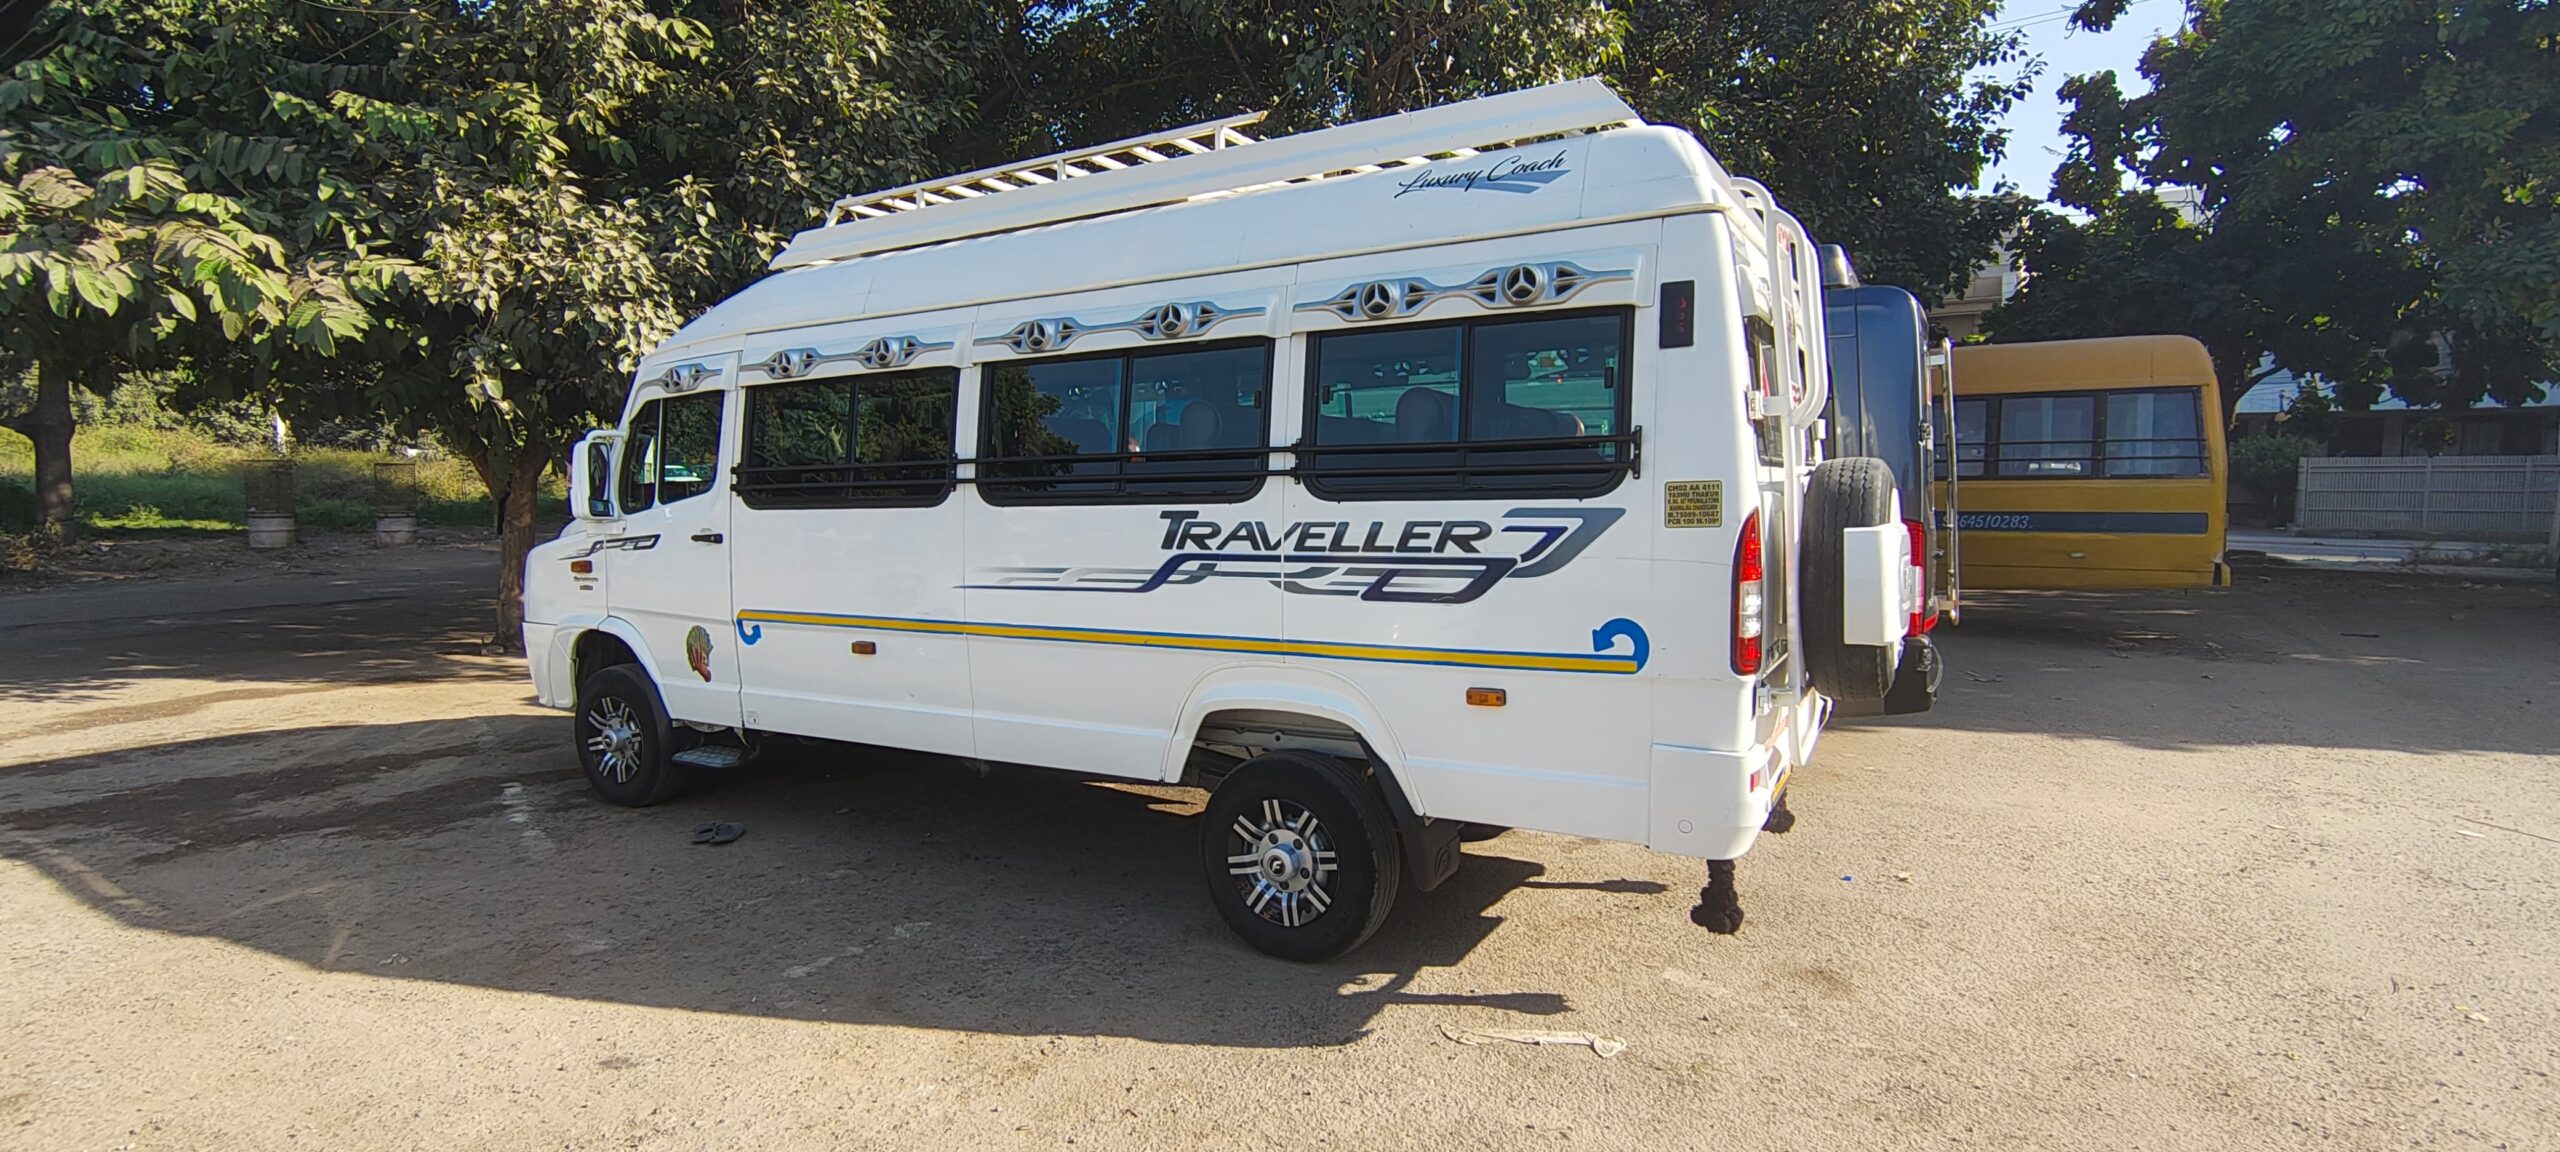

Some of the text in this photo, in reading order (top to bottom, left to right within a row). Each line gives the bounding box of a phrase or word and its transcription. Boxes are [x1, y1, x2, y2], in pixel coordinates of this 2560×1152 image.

[1393, 149, 1568, 199] Luxury Coach
[1159, 510, 1493, 554] TRAVELLER
